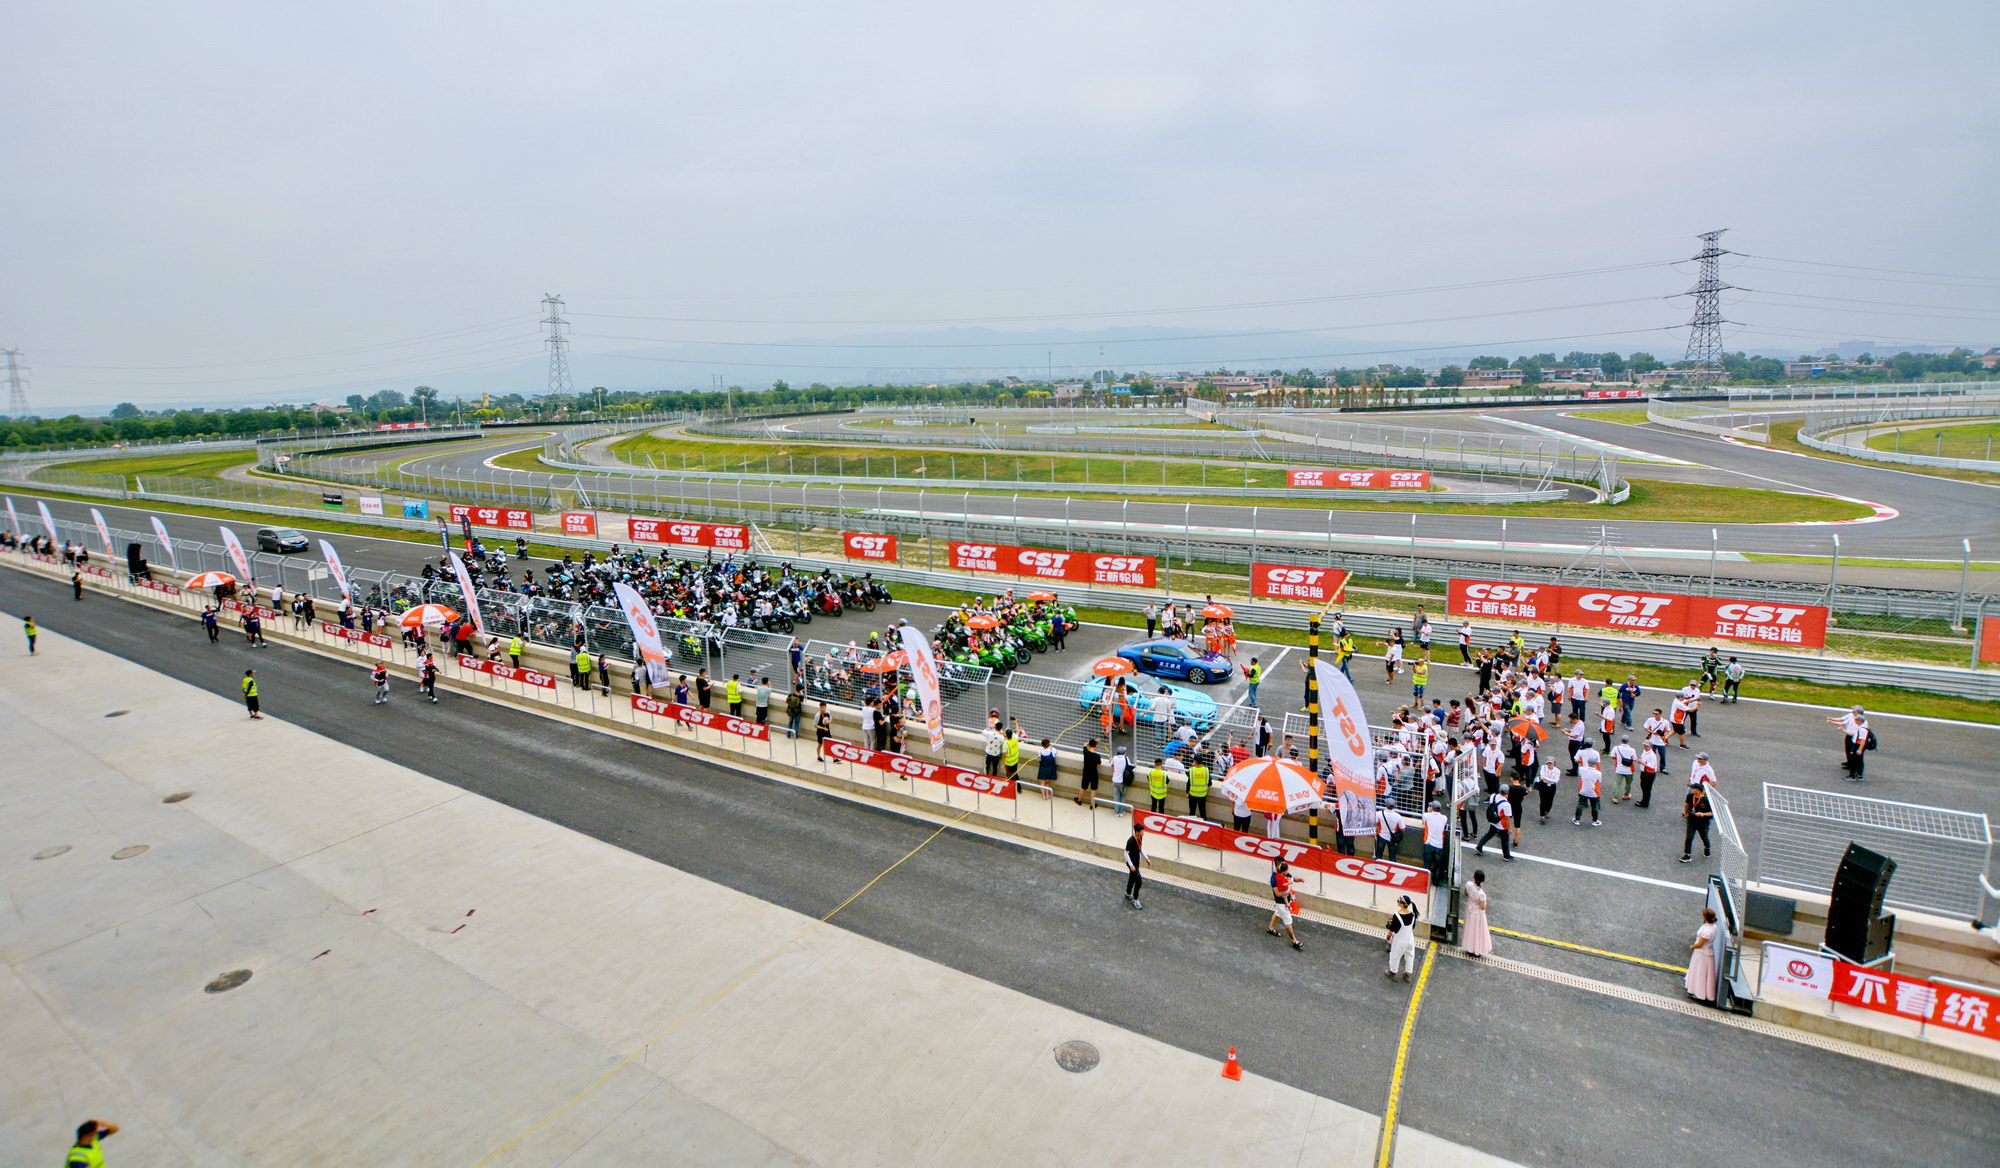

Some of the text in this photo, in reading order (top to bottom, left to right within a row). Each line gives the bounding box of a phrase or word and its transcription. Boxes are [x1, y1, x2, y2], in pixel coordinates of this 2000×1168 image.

[1339, 473, 1374, 481] CST
[453, 507, 470, 515] CST
[478, 509, 499, 519] CST
[507, 511, 527, 520] CST
[566, 515, 587, 524] CST
[633, 521, 658, 532] CST
[670, 524, 702, 537] CST
[714, 527, 743, 538] CST
[850, 535, 888, 550] CST
[863, 549, 886, 558] TIRES
[957, 545, 997, 559] CST
[1018, 551, 1070, 569] CST
[1094, 557, 1145, 572] CST
[1036, 567, 1067, 577] TIRES
[1094, 570, 1145, 584] 正新轮胎
[1267, 569, 1325, 585] CST
[1266, 582, 1323, 599] 正新轮胎
[1465, 584, 1538, 602] CST
[1464, 600, 1537, 618] 正新轮胎
[1578, 593, 1672, 617] CST
[258, 608, 273, 618] CST
[1717, 604, 1806, 625] CST
[1609, 614, 1661, 628] TIRES
[325, 624, 342, 635] CST
[346, 630, 365, 640] CST
[1715, 621, 1802, 643] 正新轮胎
[369, 635, 389, 646] CST
[462, 657, 485, 670] CST
[492, 664, 517, 678] CST
[525, 672, 552, 686] CST
[636, 698, 669, 714] CST
[679, 708, 714, 726] CST
[726, 719, 765, 737] CST
[830, 744, 875, 764] CST
[890, 757, 939, 778] CST
[956, 772, 1010, 795] CST
[1143, 815, 1210, 840] CST
[1234, 836, 1309, 862] CST
[1335, 858, 1418, 886] CST
[1848, 970, 2000, 1033] 不看统
